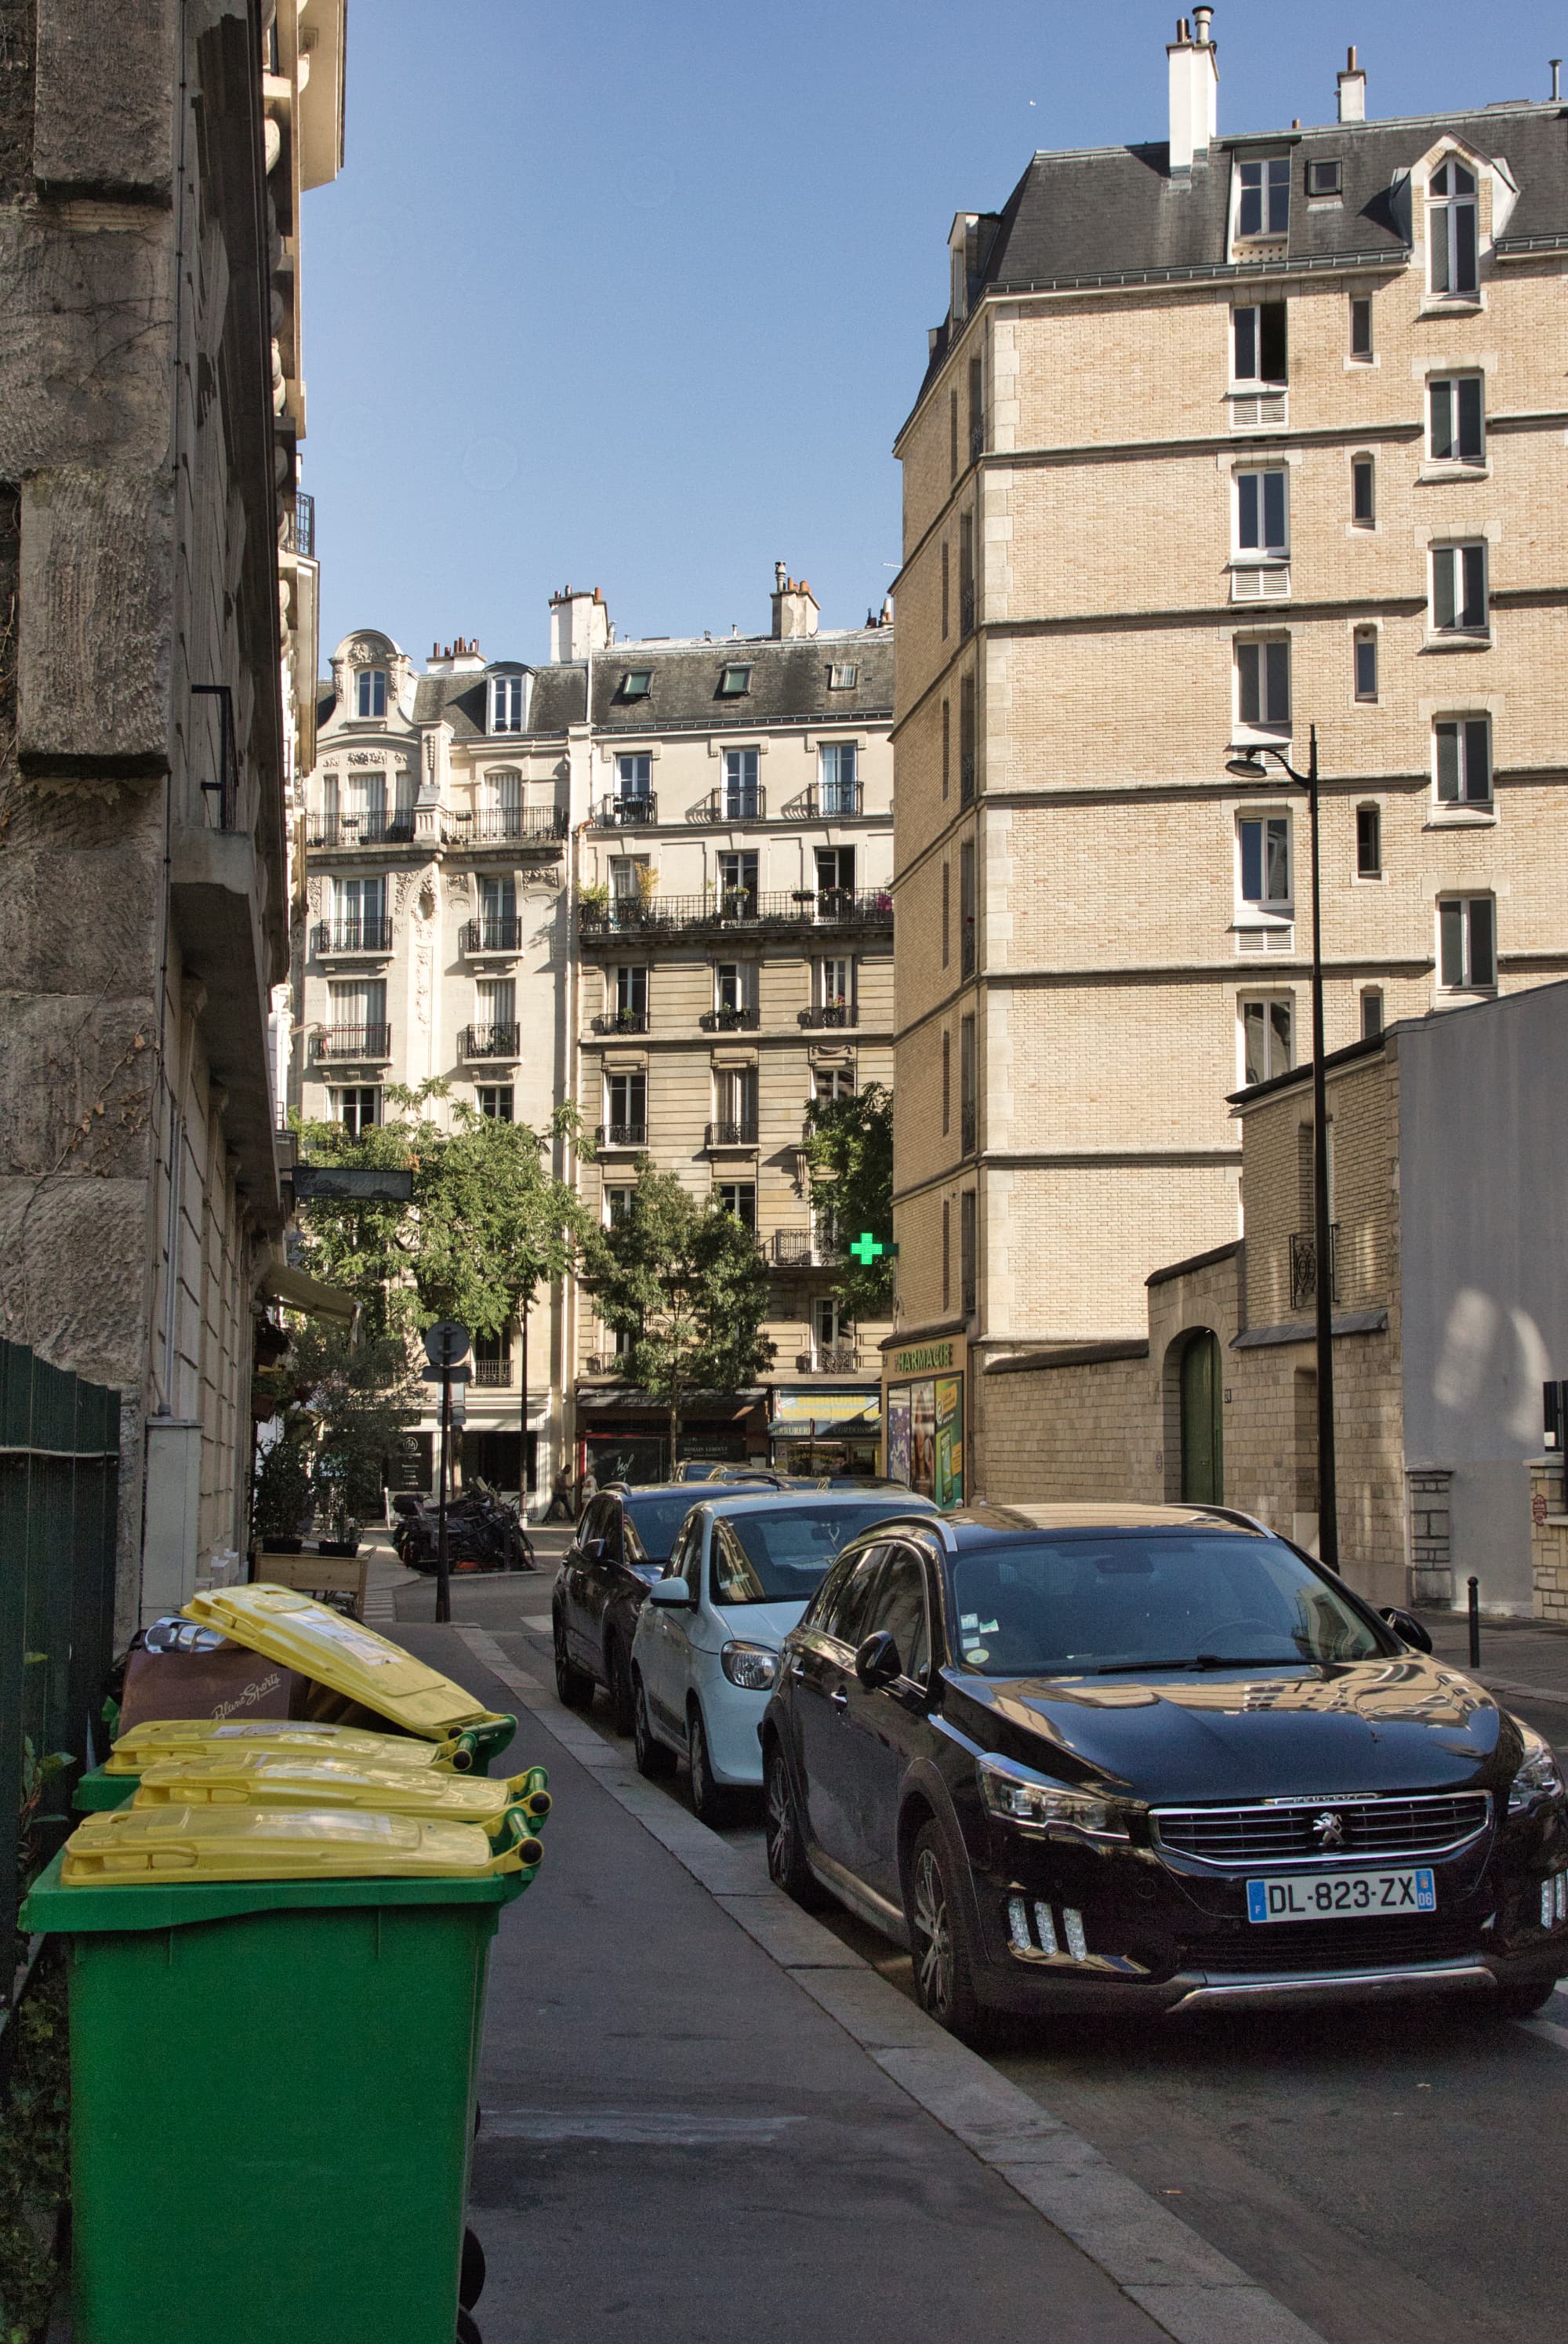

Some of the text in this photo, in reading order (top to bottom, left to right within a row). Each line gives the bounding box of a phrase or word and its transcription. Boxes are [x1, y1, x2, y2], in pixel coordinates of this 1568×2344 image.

[894, 1342, 953, 1373] PHARMACIE
[239, 1673, 281, 1706] Sports
[1269, 1877, 1416, 1913] DL-823-ZX
[1418, 1892, 1432, 1906] 06
